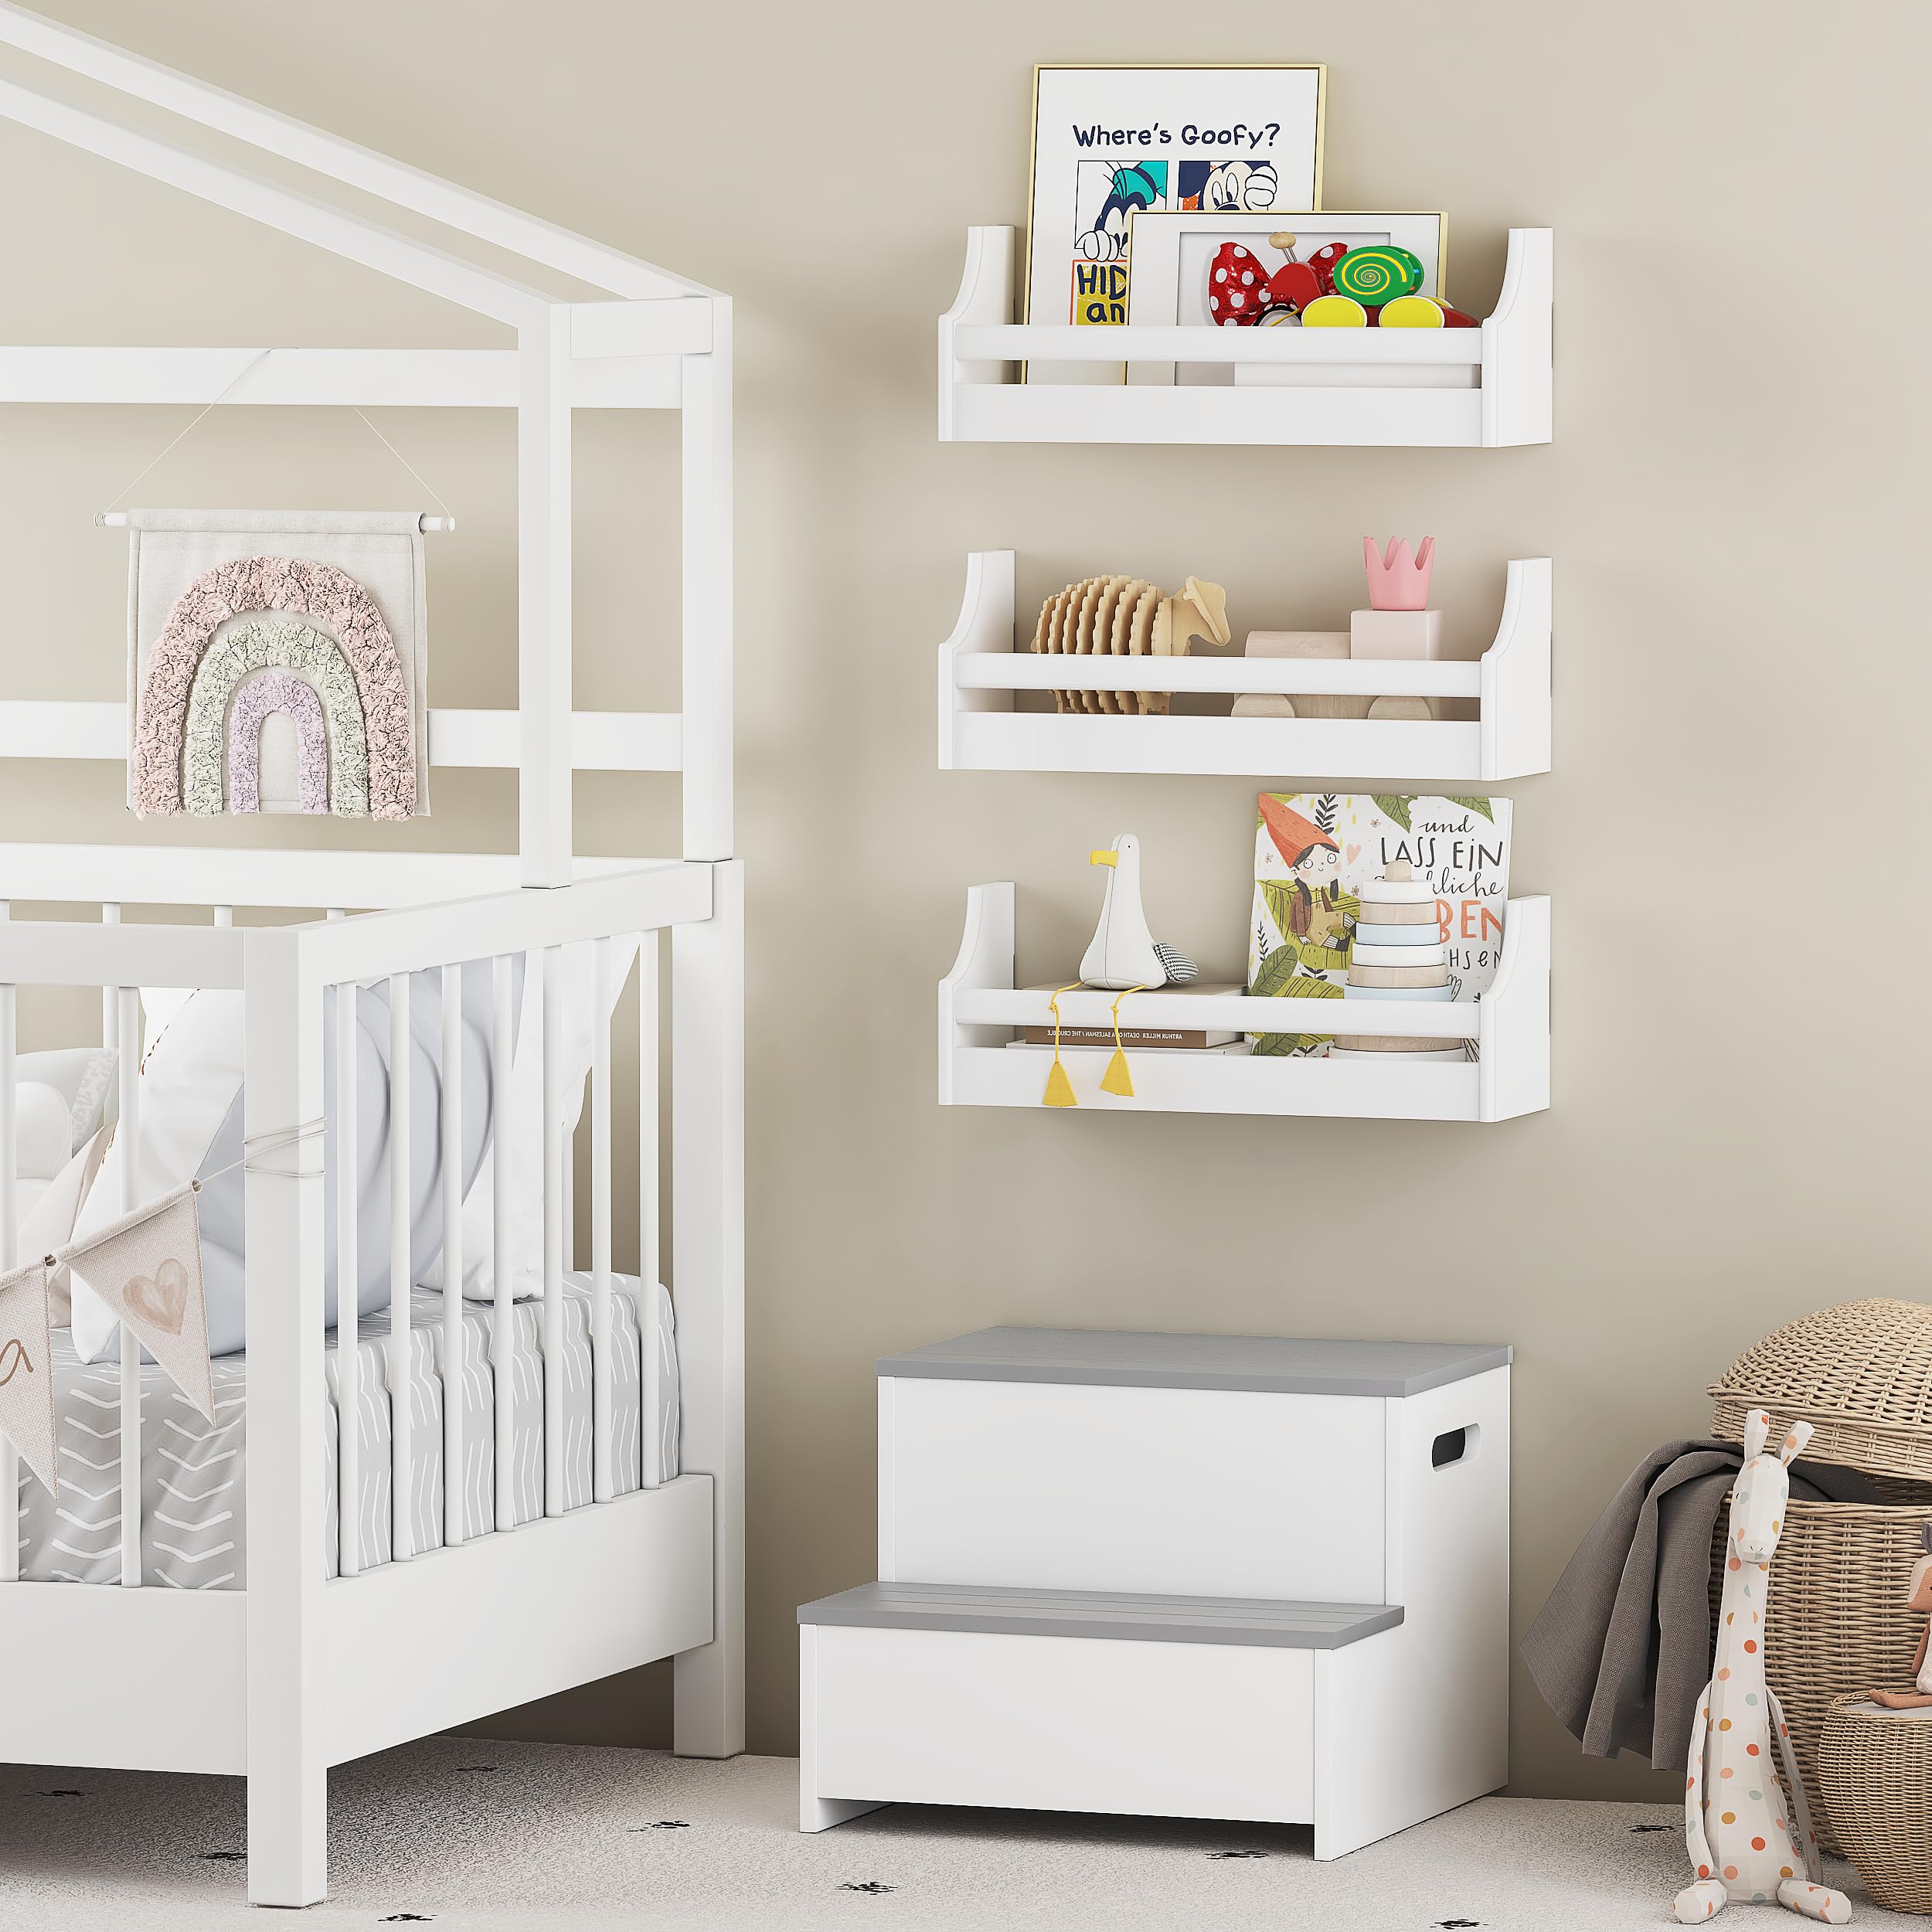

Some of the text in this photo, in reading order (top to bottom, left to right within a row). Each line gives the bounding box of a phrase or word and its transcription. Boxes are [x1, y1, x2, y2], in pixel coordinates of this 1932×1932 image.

[1073, 123, 1281, 149] Where's Goofy?
[1077, 264, 1127, 300] HID
[1086, 303, 1125, 323] an
[1418, 815, 1475, 833] und
[1381, 836, 1437, 868] LASS
[1435, 899, 1502, 944] BEN
